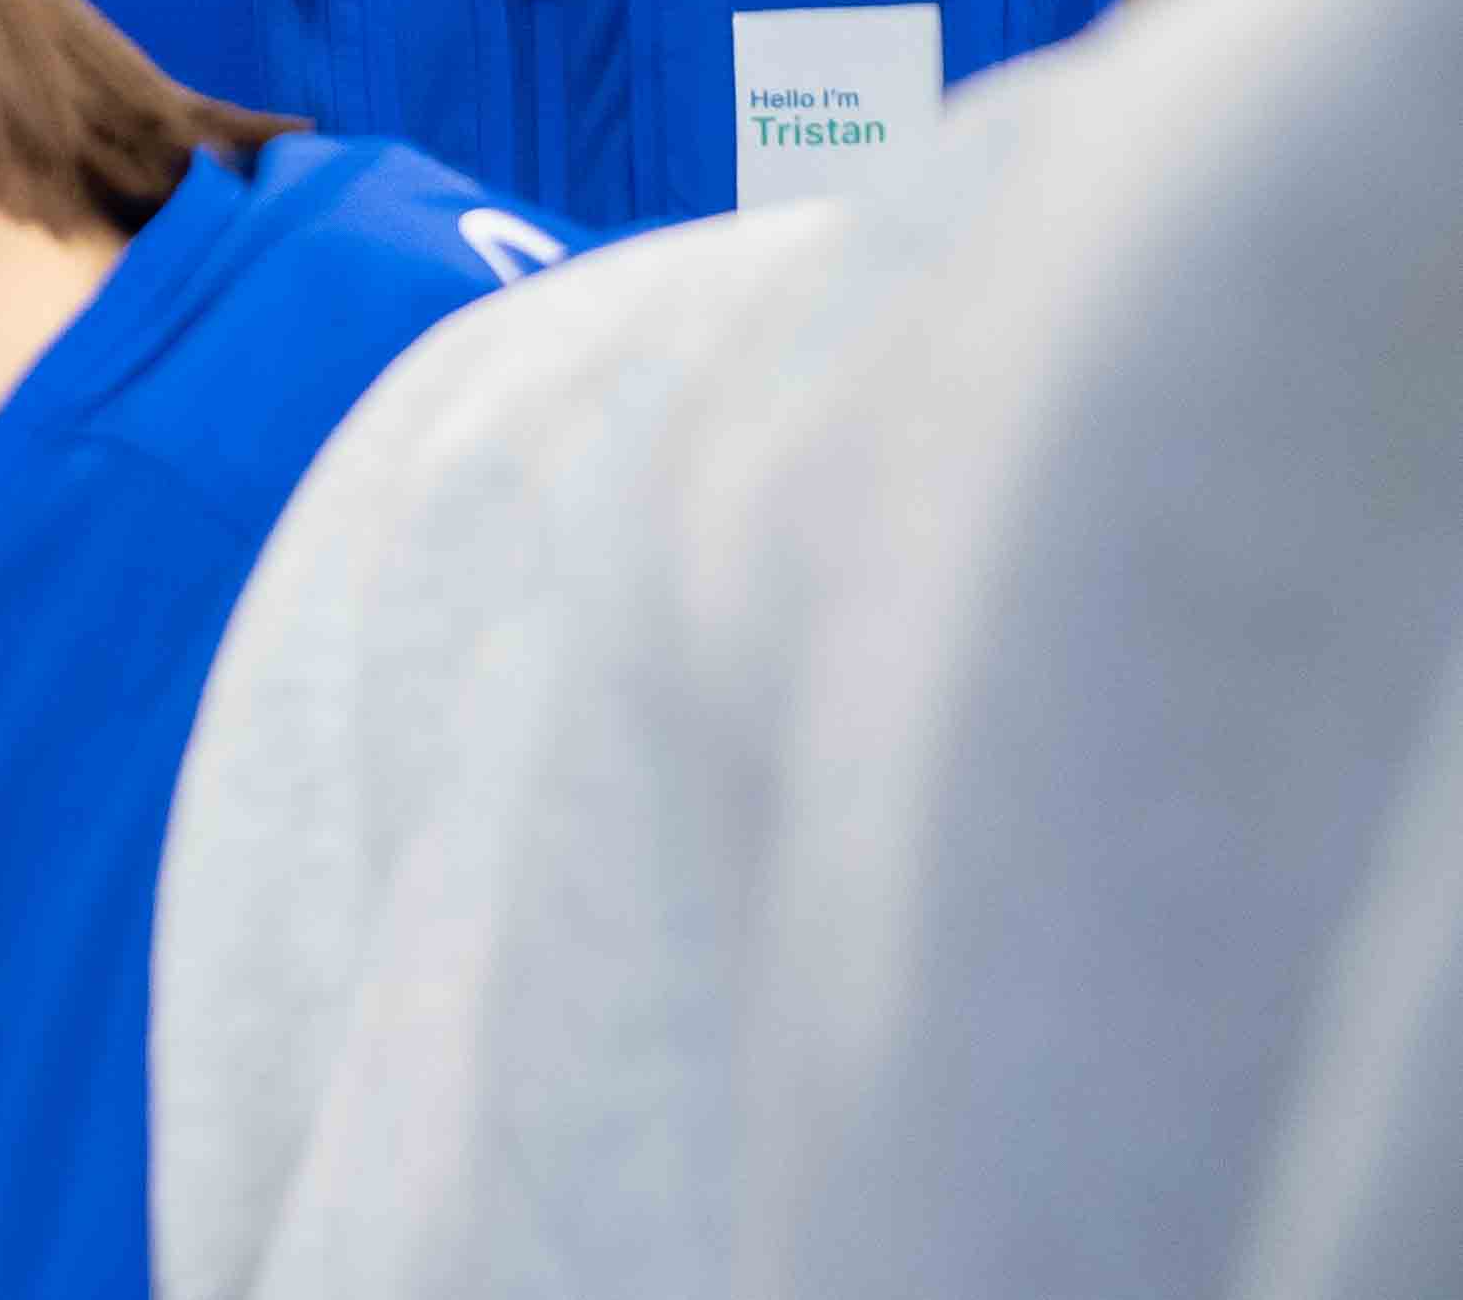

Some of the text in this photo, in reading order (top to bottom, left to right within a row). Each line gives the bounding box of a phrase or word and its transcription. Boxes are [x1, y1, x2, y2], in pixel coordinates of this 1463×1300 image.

[750, 89, 859, 109] Hello I'm
[752, 116, 886, 147] Tristan
